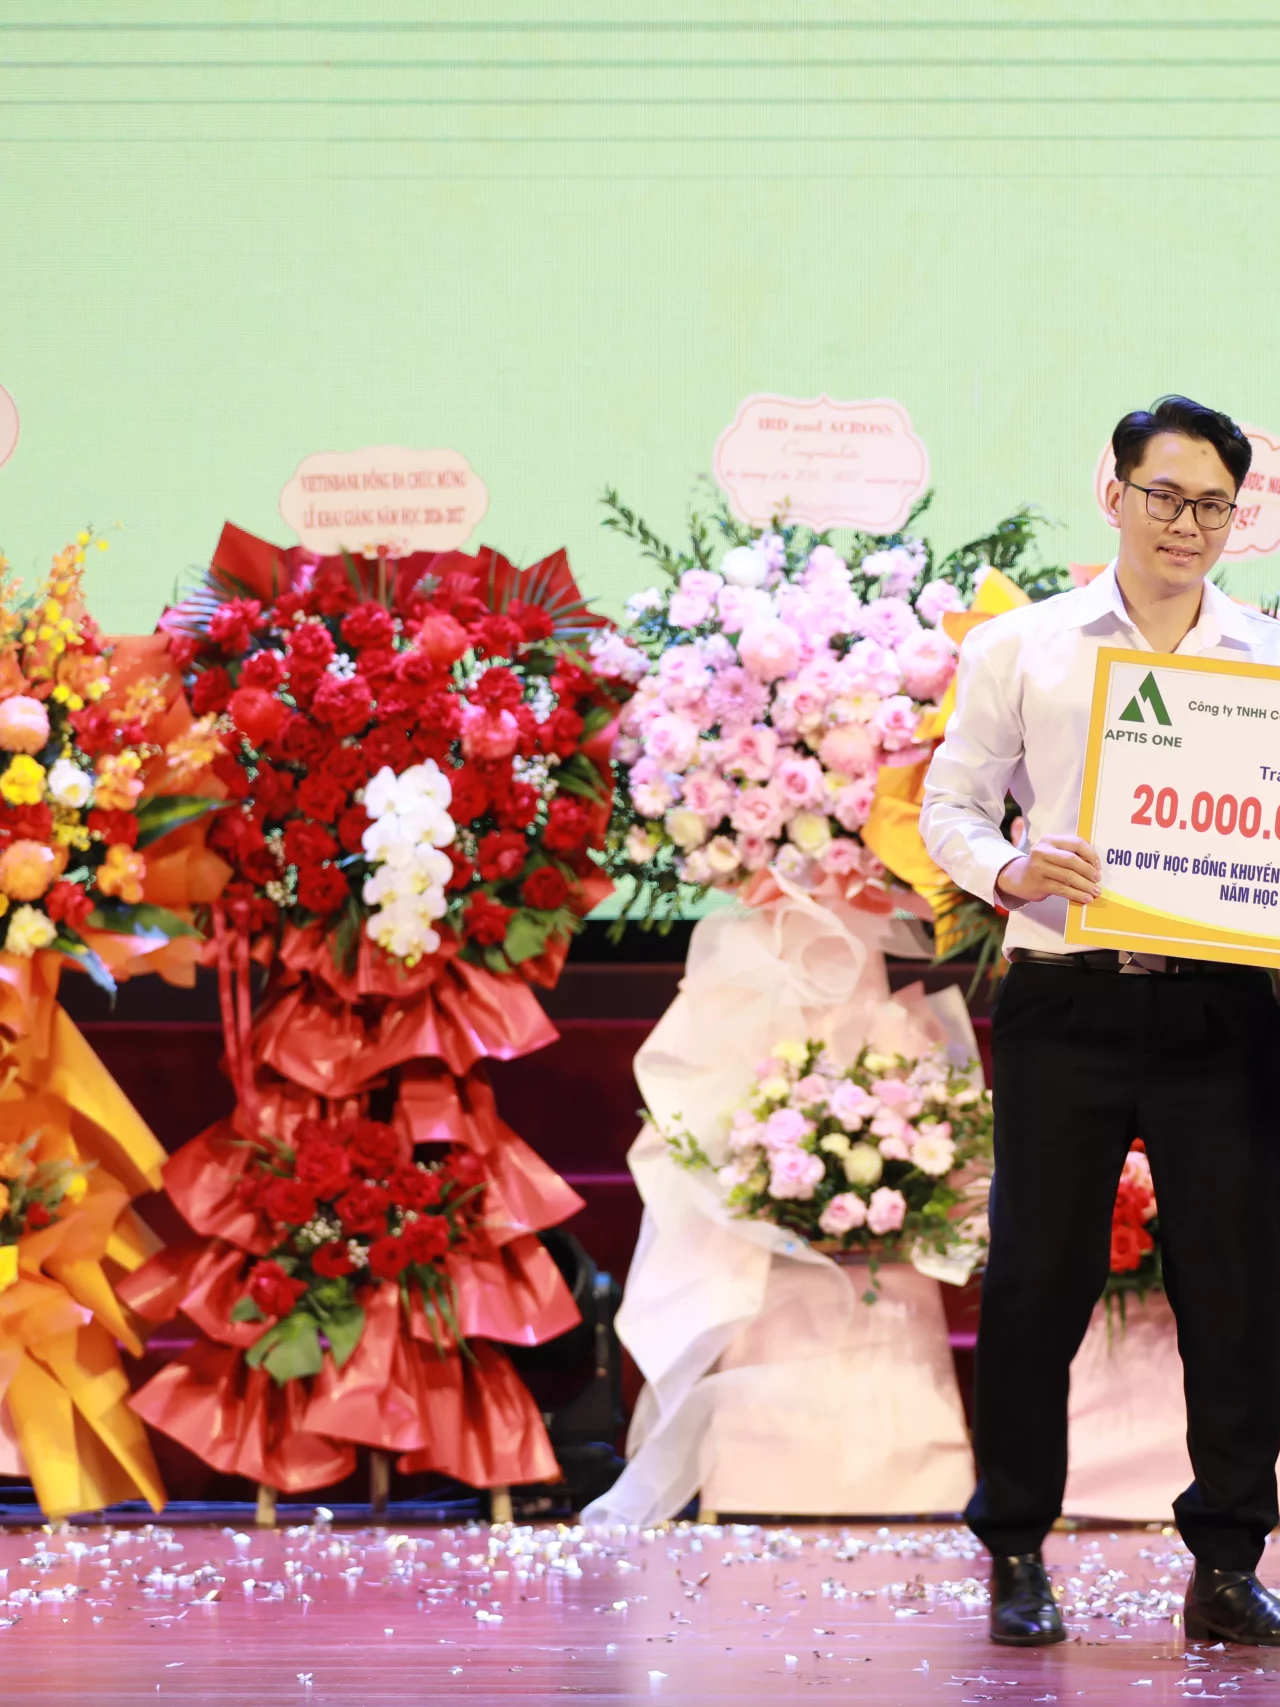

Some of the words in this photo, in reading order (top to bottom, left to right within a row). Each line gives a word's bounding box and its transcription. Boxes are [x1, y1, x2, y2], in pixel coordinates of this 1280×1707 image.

[1188, 701, 1219, 716] Công
[1223, 705, 1233, 717] ty
[1236, 706, 1267, 719] TNHH
[1104, 729, 1148, 744] APTIS
[1152, 734, 1183, 748] ONE
[1106, 848, 1132, 866] CHO
[1135, 851, 1160, 870] QUỸ
[1163, 854, 1189, 876] HỌC
[1192, 853, 1227, 878] BỔNG
[1230, 861, 1280, 884] KHUYẾN
[1219, 882, 1250, 903] NĂM
[1252, 888, 1279, 909] HỌC
